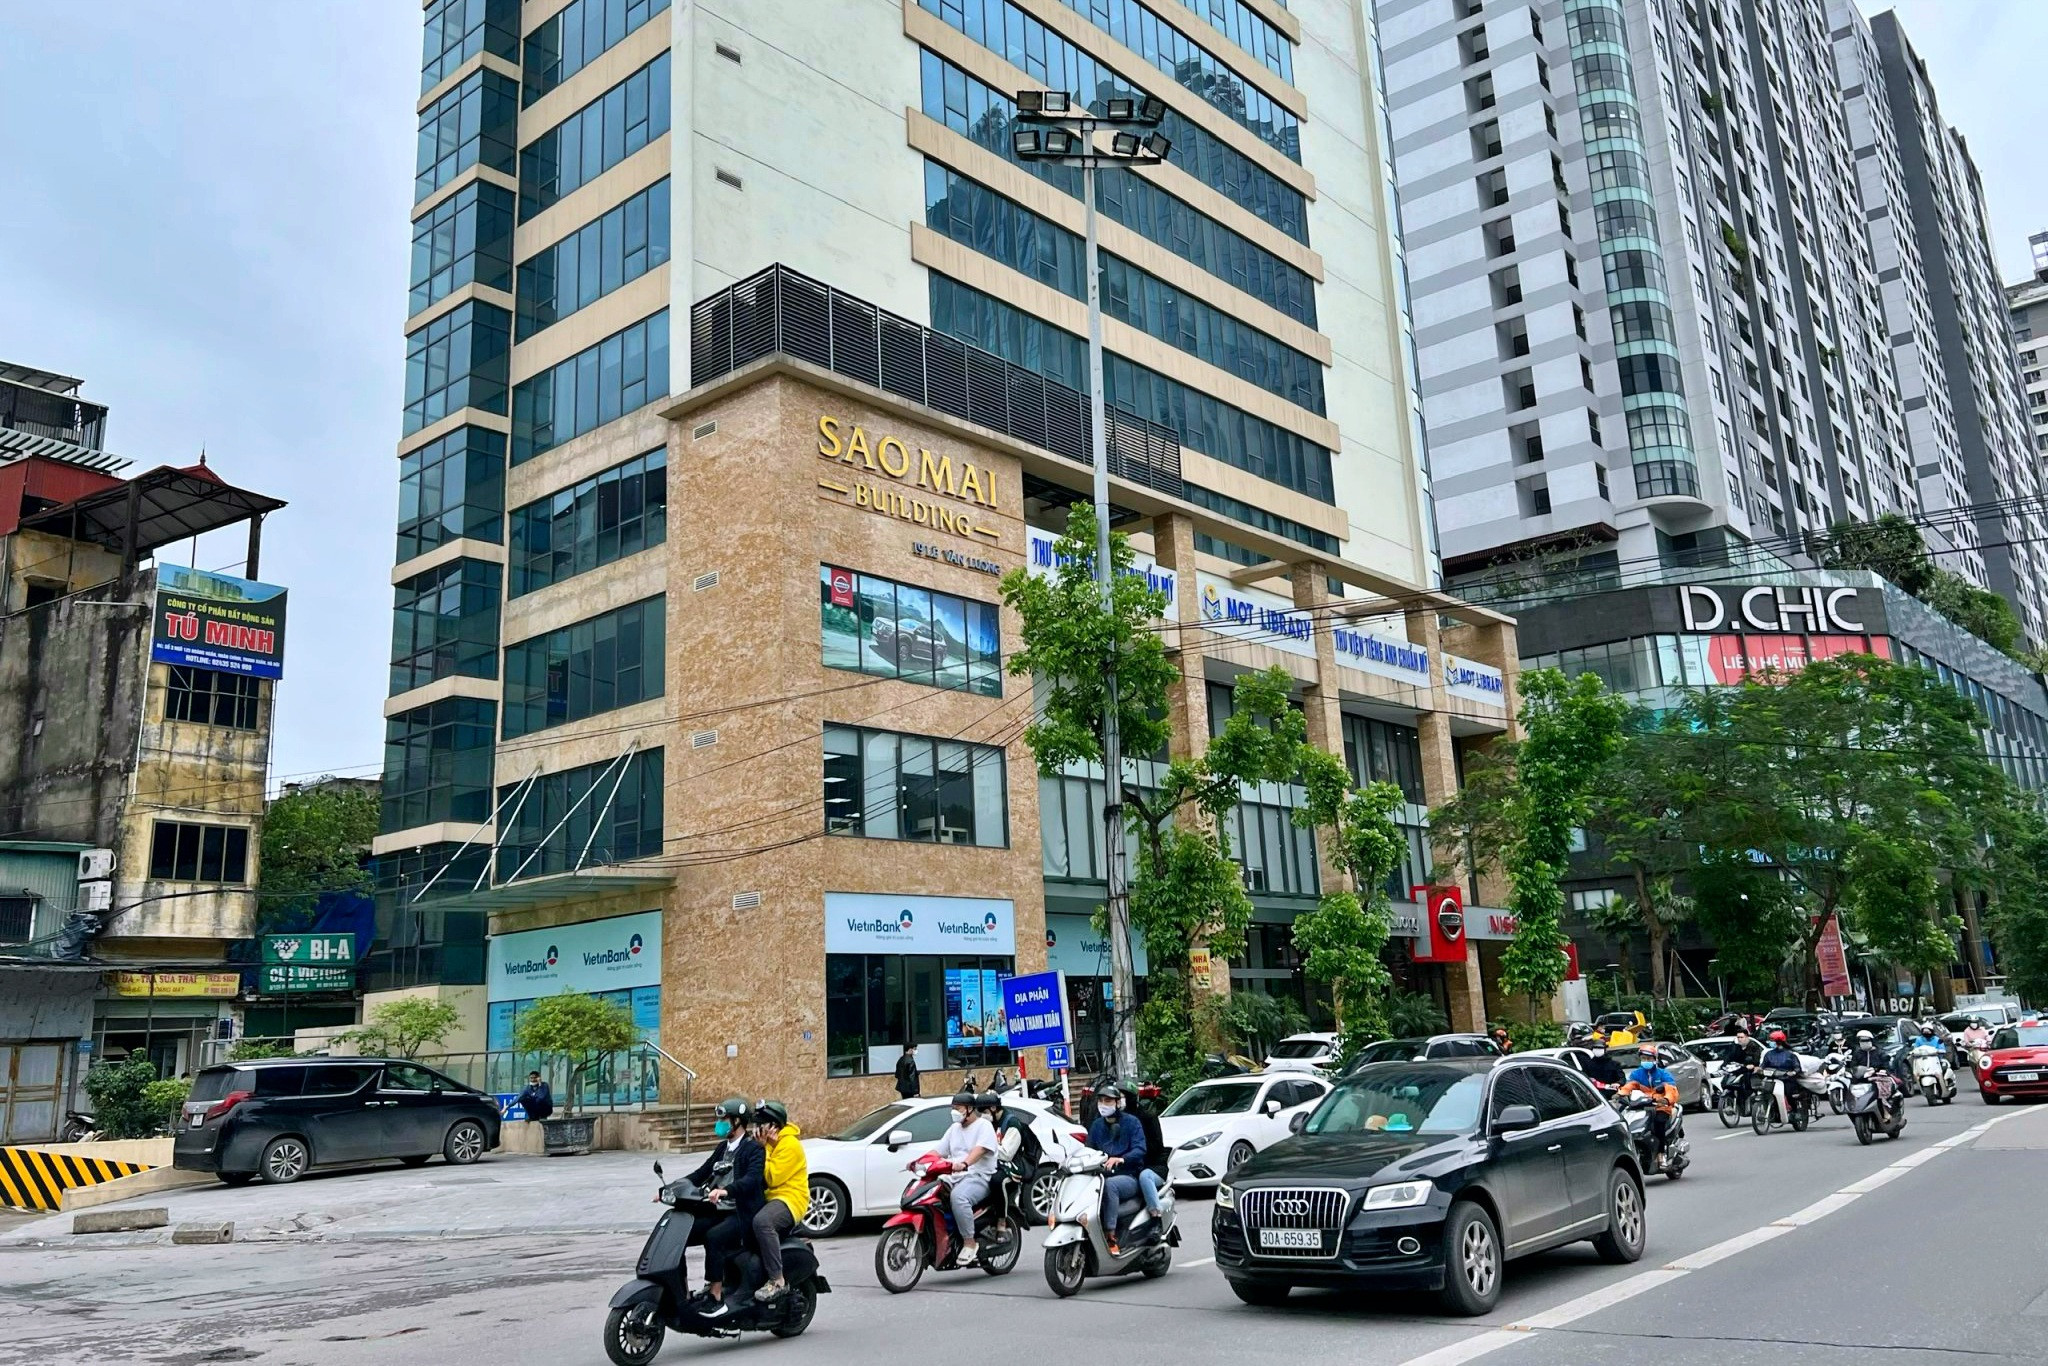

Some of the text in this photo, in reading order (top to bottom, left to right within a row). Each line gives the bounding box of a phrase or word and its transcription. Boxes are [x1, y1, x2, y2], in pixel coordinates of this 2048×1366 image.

[818, 415, 998, 509] SAO MAI
[855, 483, 971, 536] BUILDING
[188, 602, 196, 611] TY
[1680, 585, 1864, 632] D.CHIC
[1260, 606, 1311, 642] LIBRARY
[205, 620, 275, 655] MINH
[847, 918, 901, 933] VietinBank
[938, 922, 986, 935] VietinBank
[310, 938, 350, 960] BI-A
[583, 947, 631, 966] VietinBank
[505, 958, 548, 975] VietinBank
[1028, 986, 1049, 1004] PHẬN
[1009, 1009, 1061, 1036] QUẬN THANH XUÂN
[1262, 1231, 1320, 1246] 30A-659.35
